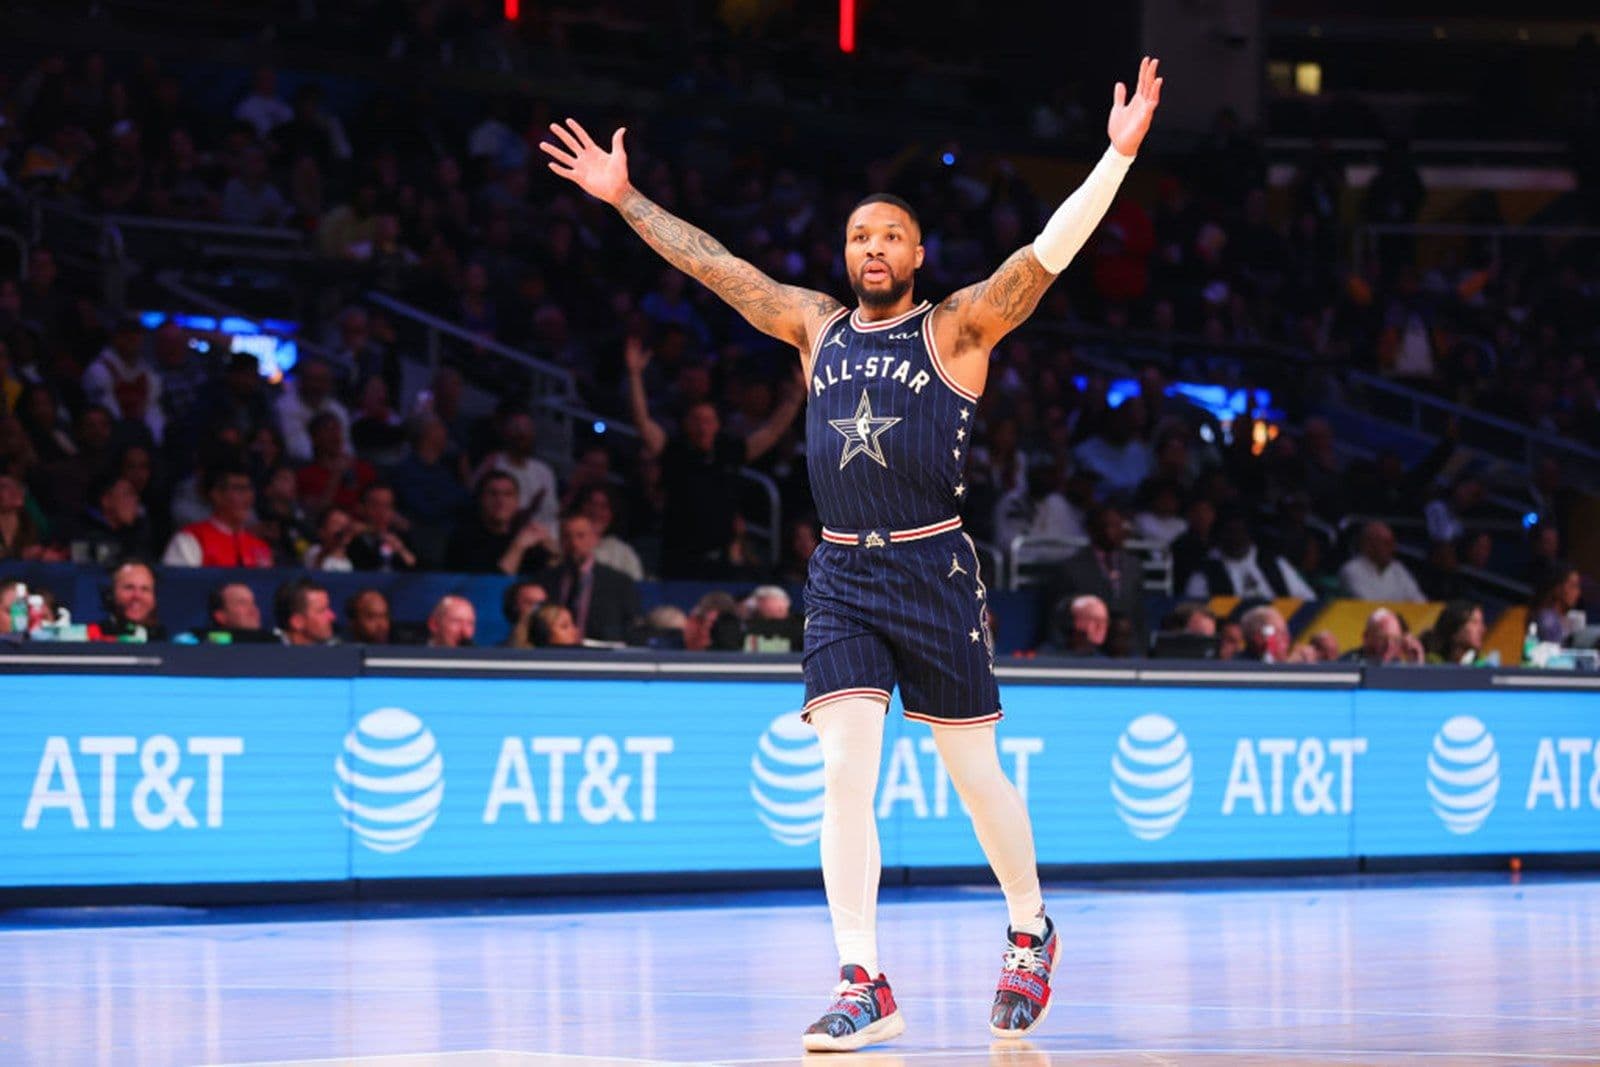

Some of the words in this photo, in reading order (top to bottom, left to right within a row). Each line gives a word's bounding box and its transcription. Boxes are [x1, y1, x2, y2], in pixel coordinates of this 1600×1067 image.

[813, 356, 931, 397] ALL-STAR
[22, 734, 244, 830] AT&T
[483, 735, 674, 824] AT&T
[877, 738, 1044, 819] ATT
[1221, 738, 1368, 816] AT&T
